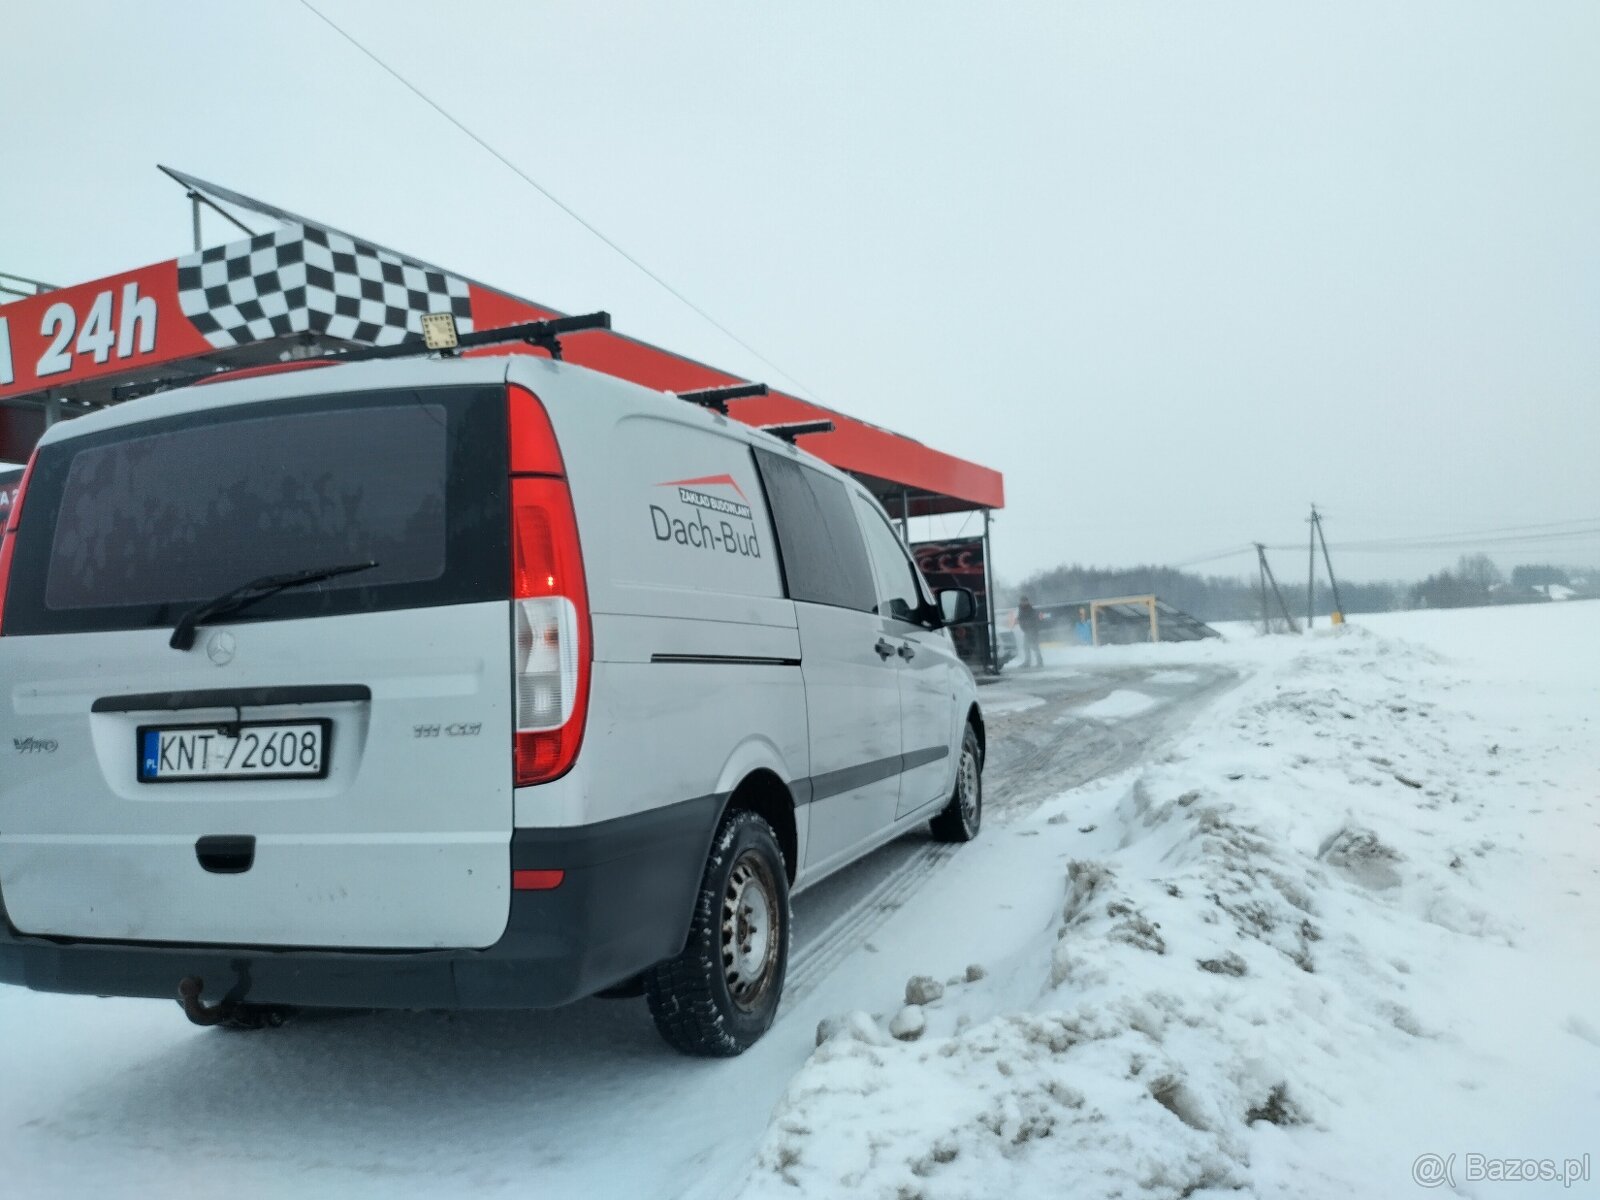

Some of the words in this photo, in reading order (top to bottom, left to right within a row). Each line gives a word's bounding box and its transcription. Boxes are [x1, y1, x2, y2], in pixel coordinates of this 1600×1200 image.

[36, 281, 158, 377] 24h
[649, 504, 761, 558] Dach-Bud
[146, 760, 157, 769] PL
[160, 734, 215, 771] KNT
[225, 730, 317, 769] 72608
